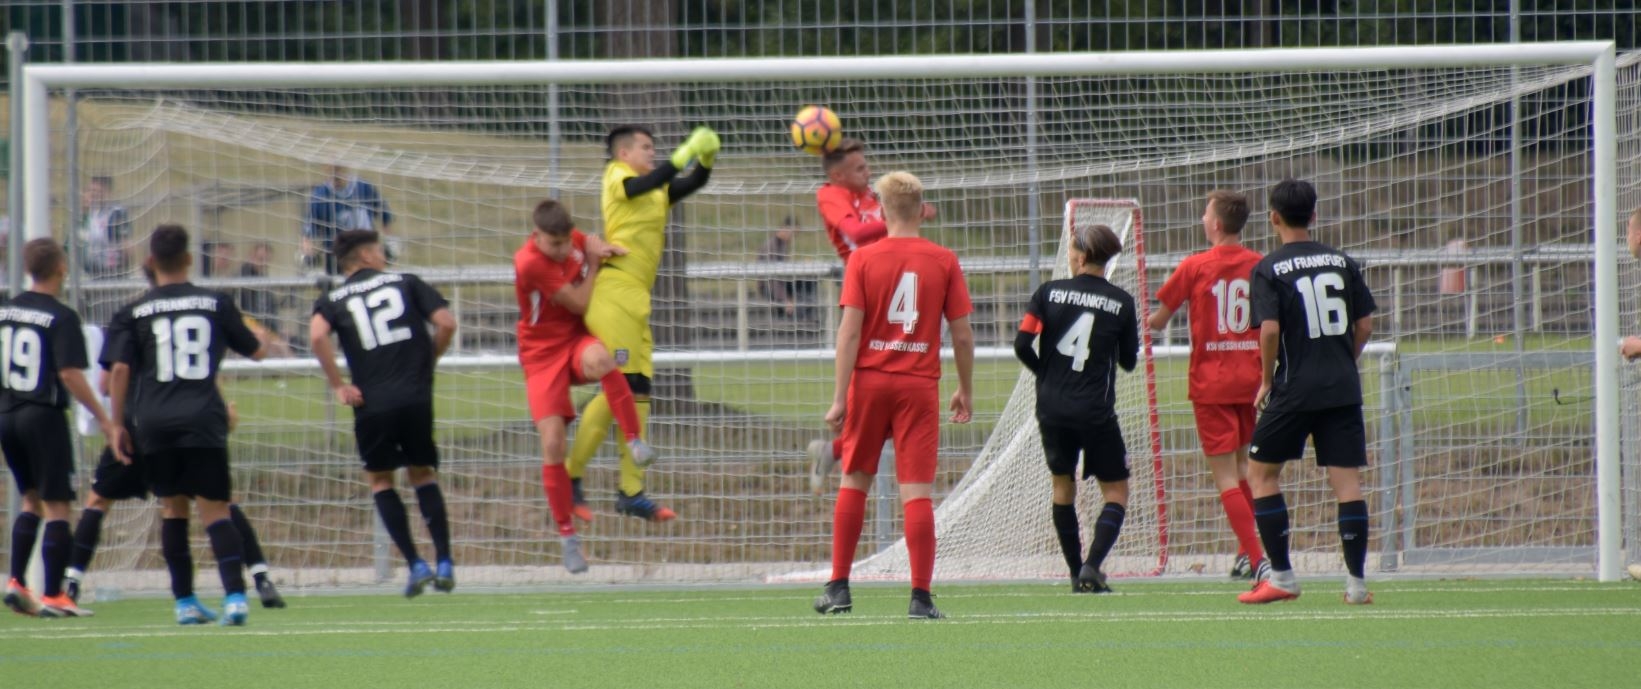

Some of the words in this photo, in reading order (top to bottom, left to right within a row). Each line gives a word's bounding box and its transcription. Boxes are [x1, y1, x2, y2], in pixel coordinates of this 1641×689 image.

[328, 285, 349, 301] FSV
[1273, 258, 1294, 276] FSV
[1293, 253, 1347, 269] FRANKFURT
[133, 302, 154, 318] FSV
[154, 295, 218, 312] FRANKFURT
[346, 286, 412, 351] 12
[887, 271, 919, 335] 4
[1048, 289, 1068, 304] FSV
[1067, 290, 1122, 316] FRANKFURT
[1211, 278, 1251, 335] 16
[1296, 272, 1349, 339] 16
[0, 325, 41, 392] 19
[151, 315, 211, 382] 18
[907, 342, 928, 353] KASSE
[1056, 311, 1095, 372] 4
